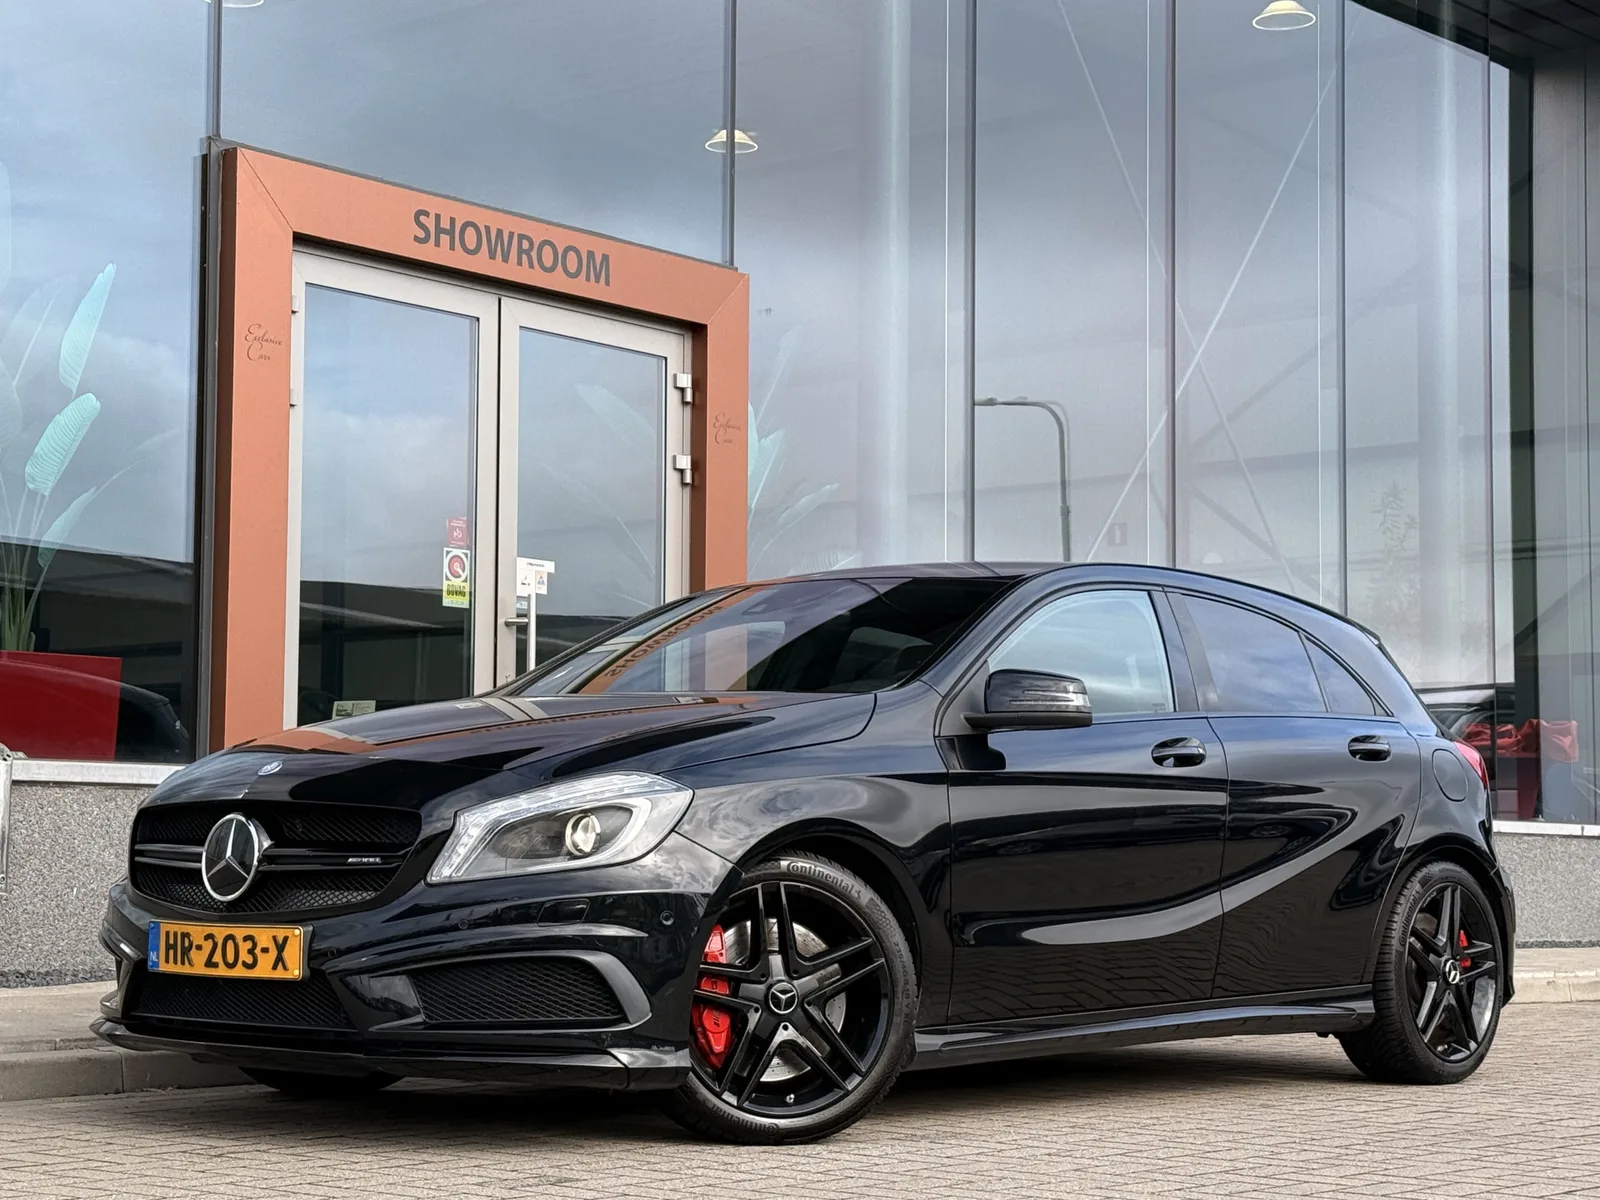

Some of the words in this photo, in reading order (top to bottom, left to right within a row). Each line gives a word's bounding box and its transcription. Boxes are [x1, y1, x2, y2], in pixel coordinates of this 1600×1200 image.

[413, 208, 611, 287] SHOWROOM
[786, 860, 853, 895] Continental
[149, 951, 159, 962] NL
[164, 930, 289, 971] HR-203-X
